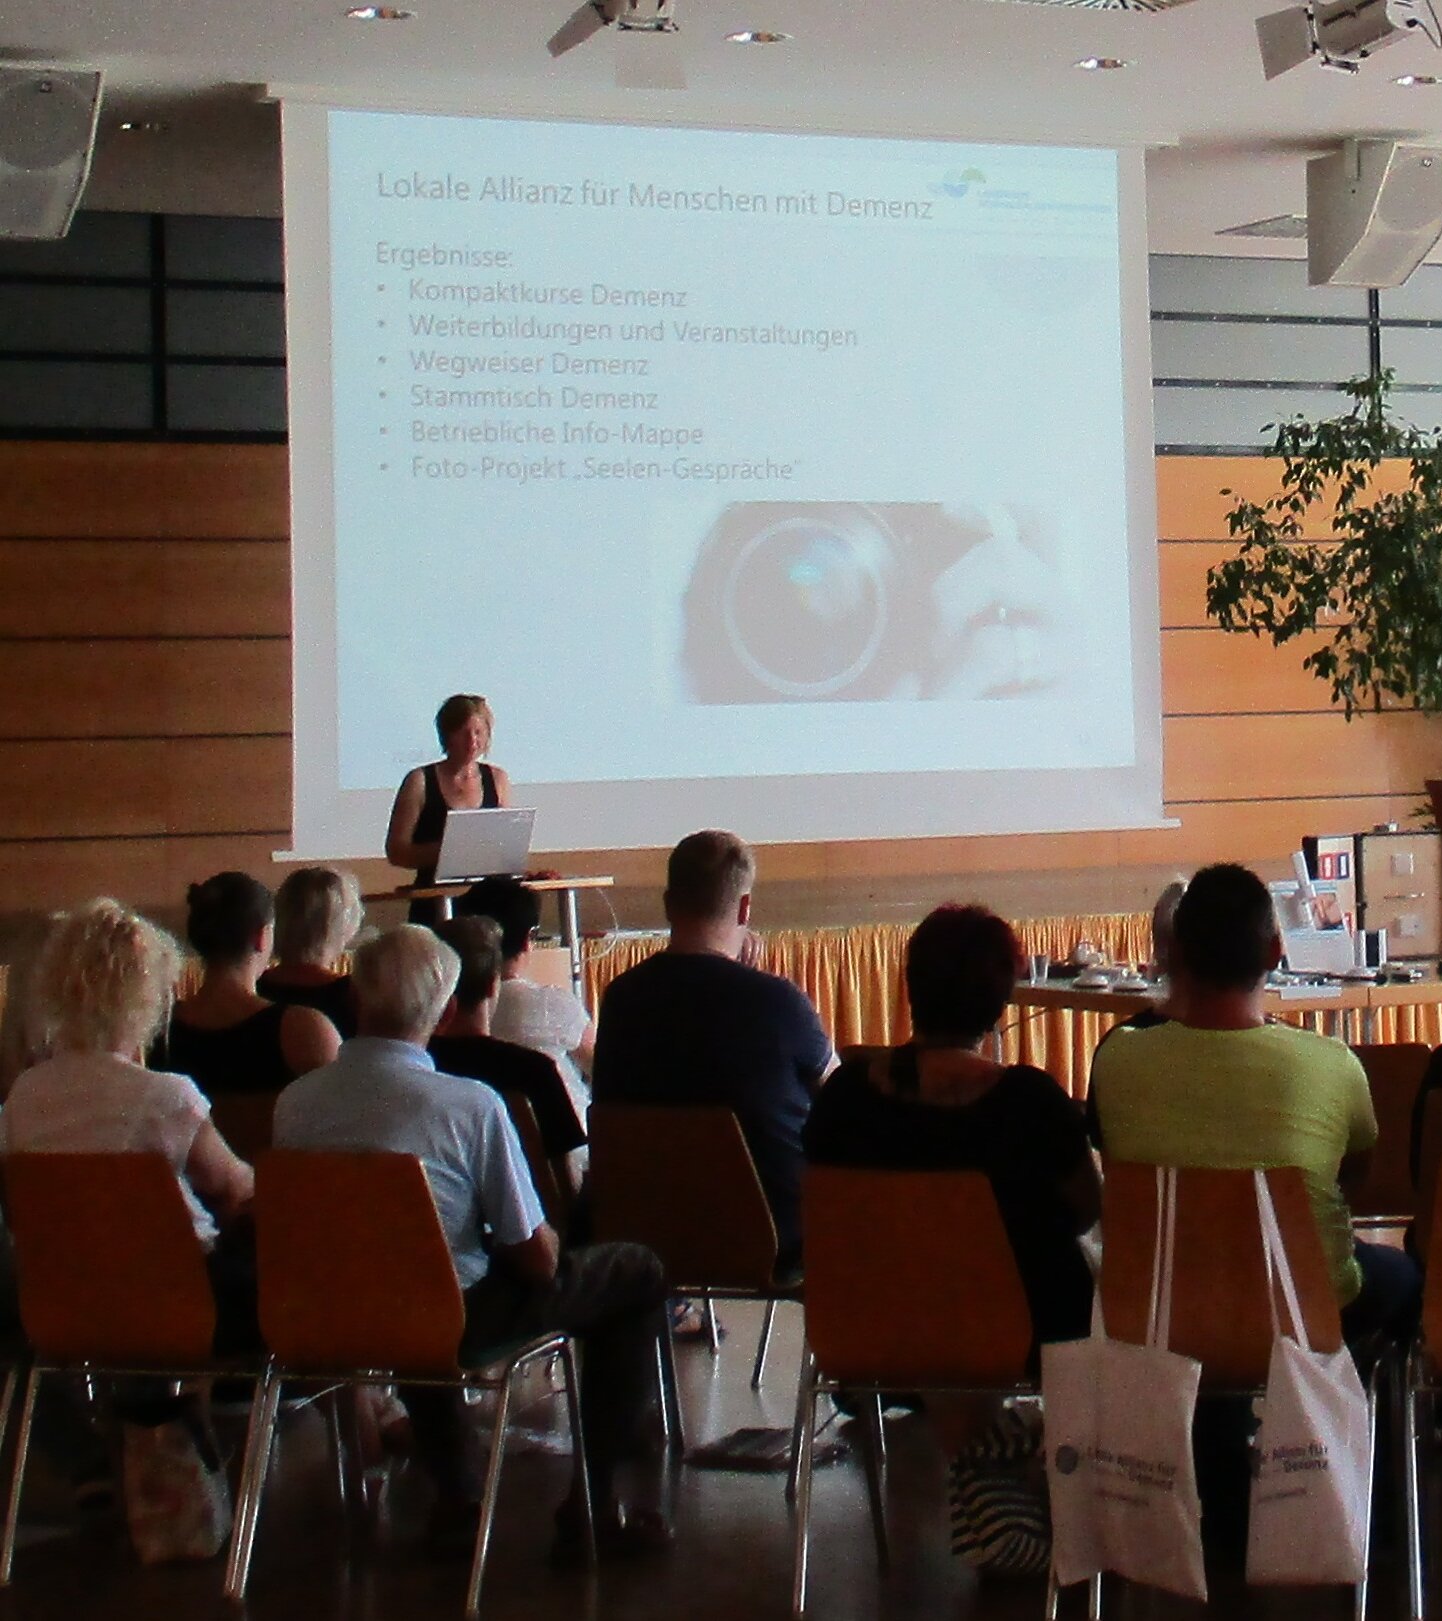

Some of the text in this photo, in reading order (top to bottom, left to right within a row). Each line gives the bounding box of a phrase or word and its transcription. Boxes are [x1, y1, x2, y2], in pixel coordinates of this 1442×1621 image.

[377, 172, 934, 220] Lokale Allianz für Menschen mit Demenz
[375, 240, 513, 271] Ergebnisse:
[408, 278, 688, 308] Kompaktkurse Demenz
[408, 313, 857, 351] Weiterbildungen und Veranstaltungen
[409, 350, 649, 379] Wegweiser Demenz
[409, 384, 659, 410] Stammtisch Demenz
[411, 419, 704, 451] Betriebliche Info-Mappe
[411, 455, 567, 485] Foto-Projekt
